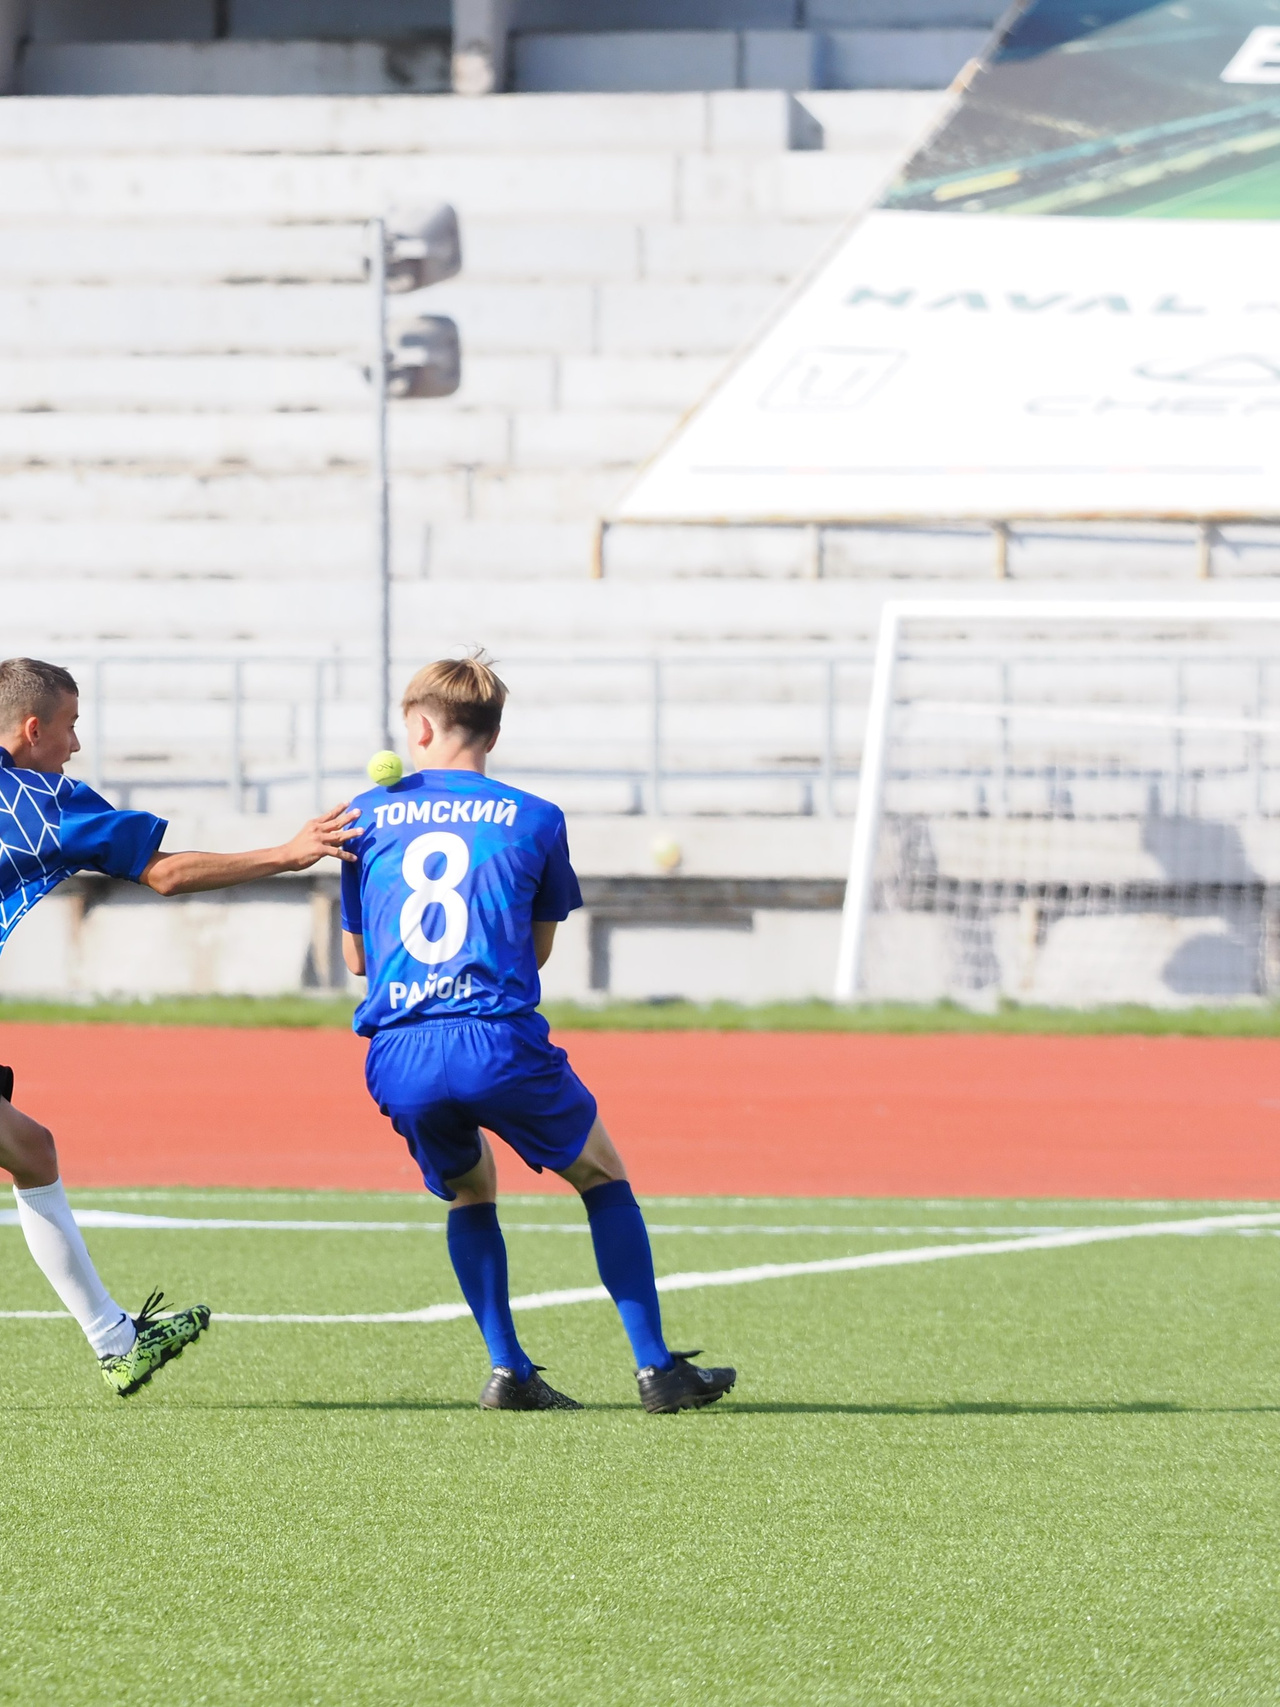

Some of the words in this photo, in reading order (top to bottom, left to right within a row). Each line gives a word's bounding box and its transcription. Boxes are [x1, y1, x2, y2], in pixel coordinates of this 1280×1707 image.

[373, 798, 518, 828] ТОМСКИЙ
[399, 831, 469, 965] 8
[389, 973, 472, 1010] РАЙОН
